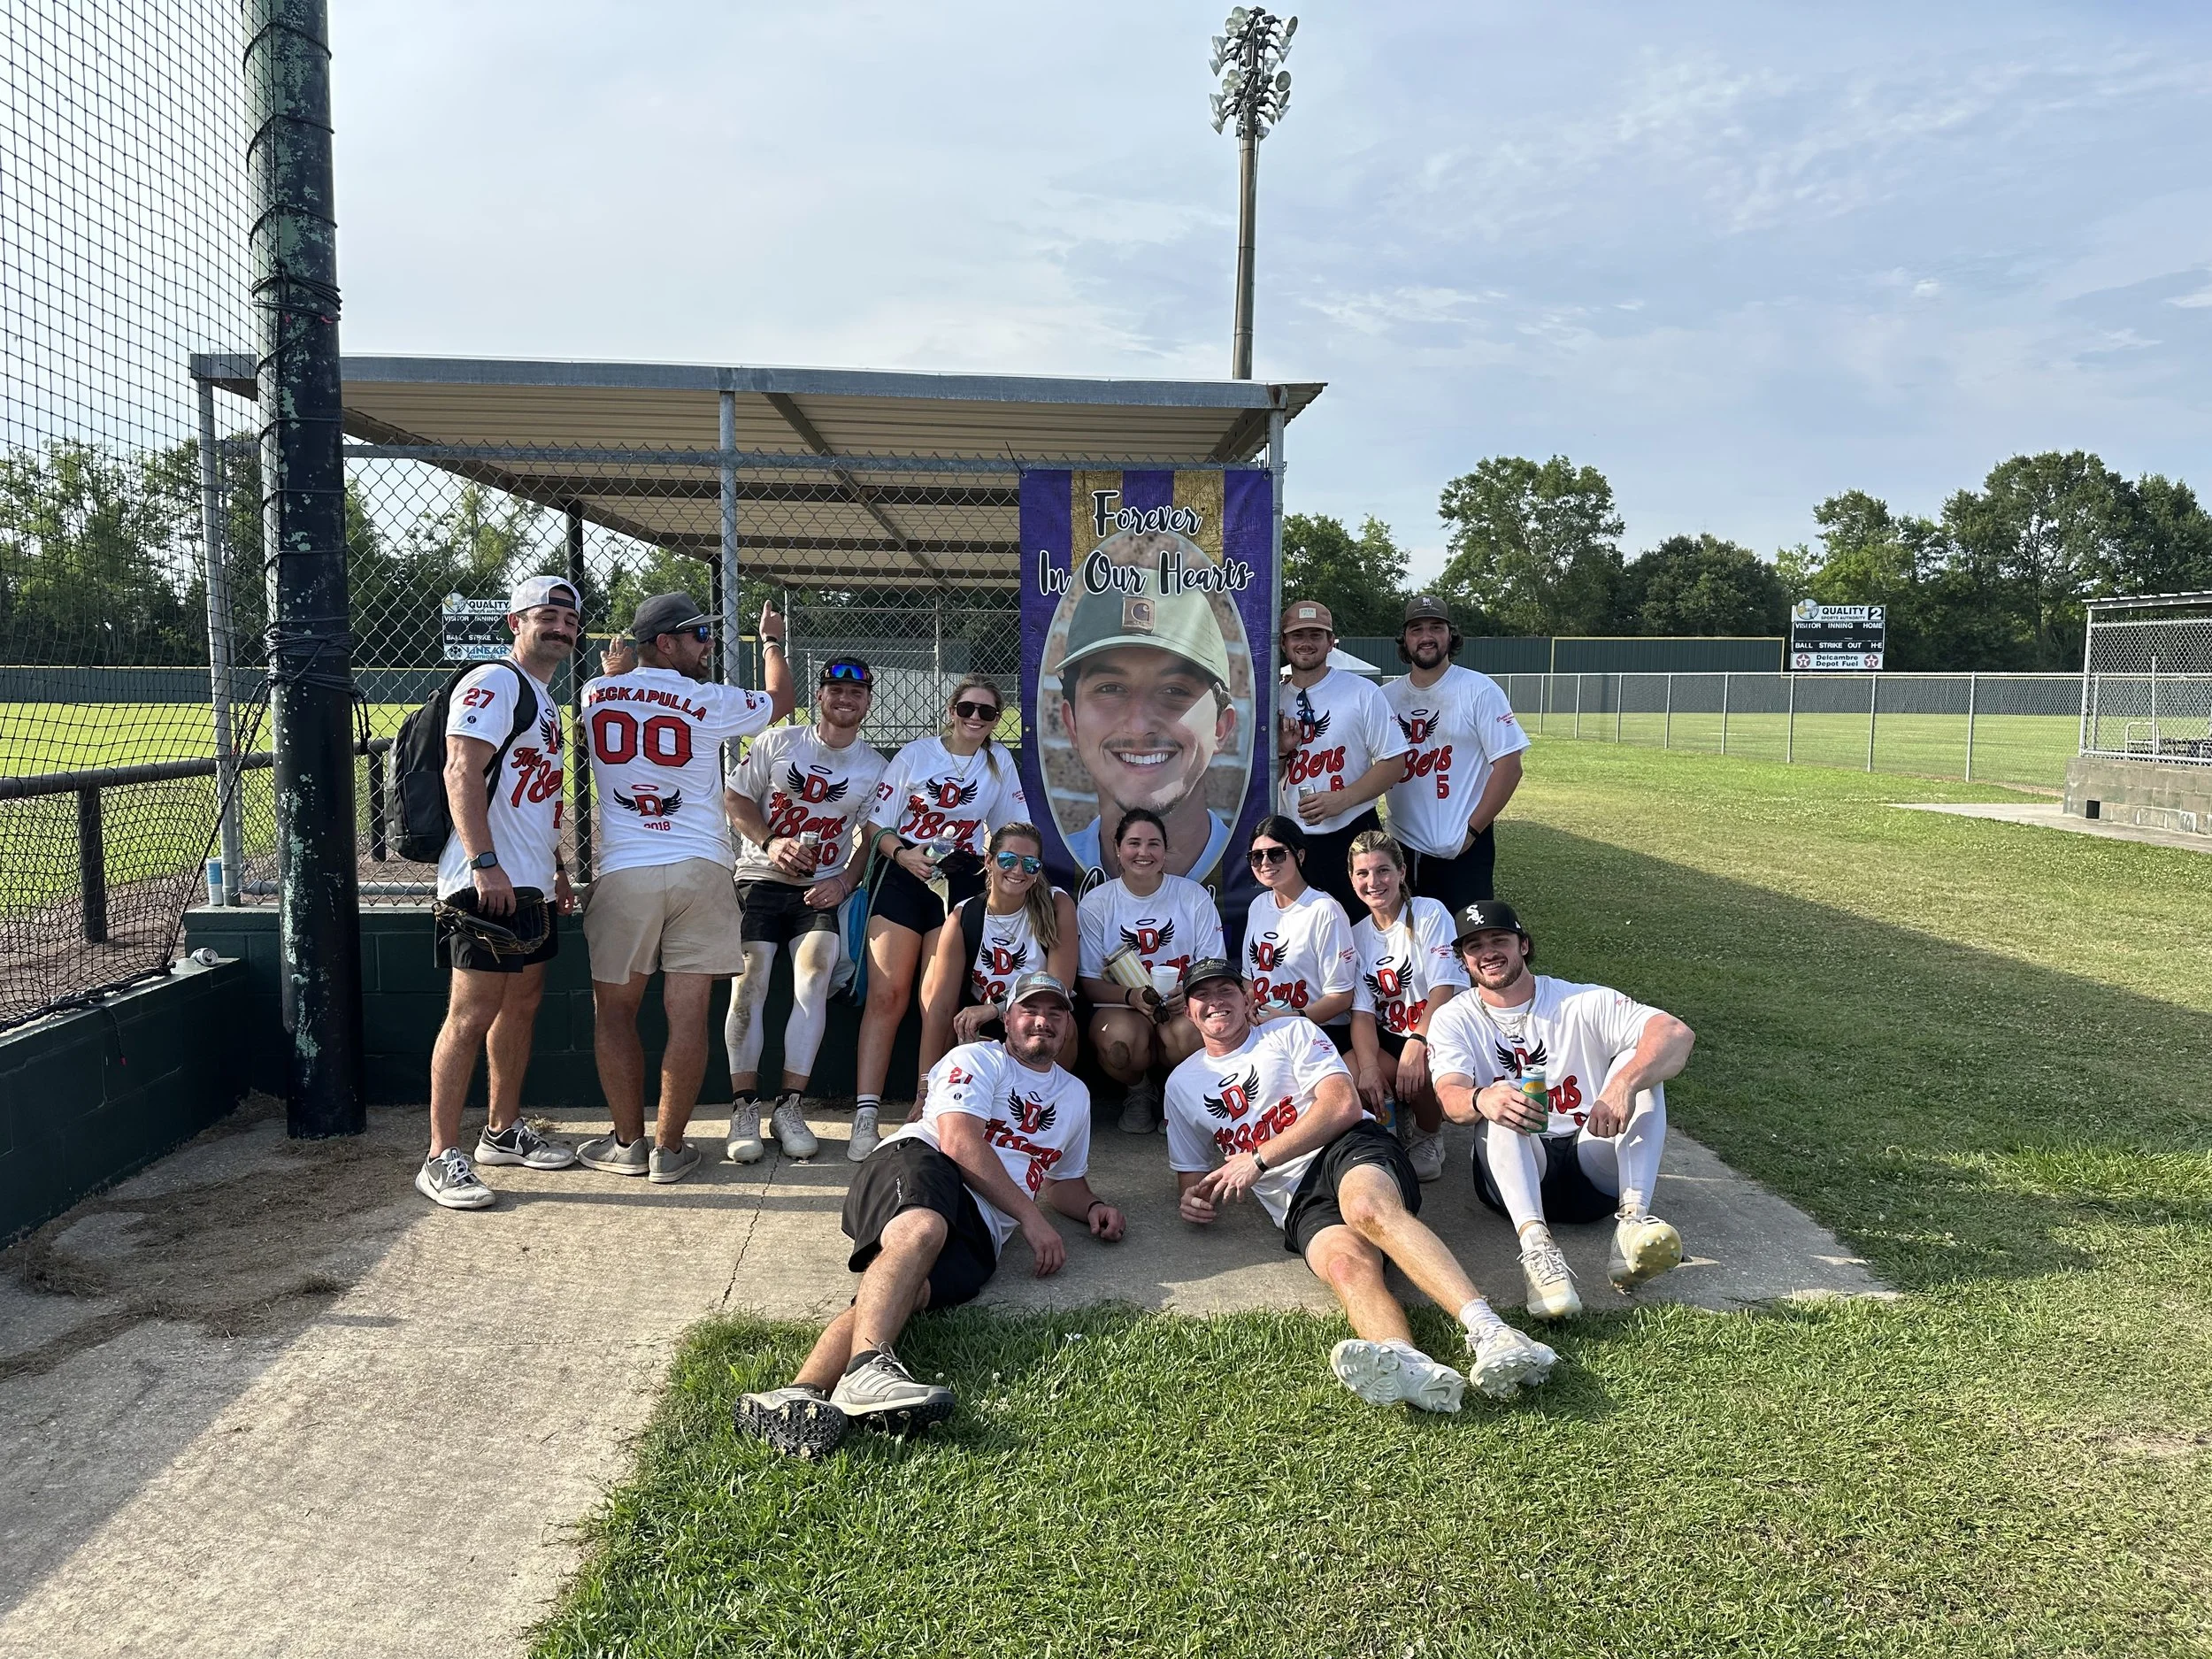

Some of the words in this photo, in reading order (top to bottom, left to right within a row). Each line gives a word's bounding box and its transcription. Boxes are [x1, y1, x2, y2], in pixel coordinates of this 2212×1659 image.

[1092, 490, 1203, 536] Forever
[1039, 549, 1071, 595] In
[1084, 549, 1148, 595] Our
[1158, 550, 1255, 595] Hearts
[1870, 607, 1882, 619] 2
[462, 687, 495, 710] 27
[592, 708, 694, 768] 00
[511, 747, 542, 769] The
[1397, 744, 1453, 784] 8ers
[768, 792, 794, 809] The
[798, 772, 830, 803] D
[934, 782, 962, 810] D
[1436, 774, 1450, 800] 5
[634, 794, 664, 818] D
[907, 795, 930, 814] The
[1139, 927, 1161, 956] D
[1257, 941, 1275, 972] D
[991, 946, 1014, 976] D
[1253, 976, 1310, 1009] 8ers
[1376, 968, 1403, 999] D
[1016, 1101, 1041, 1134] D
[1220, 1085, 1250, 1123] D
